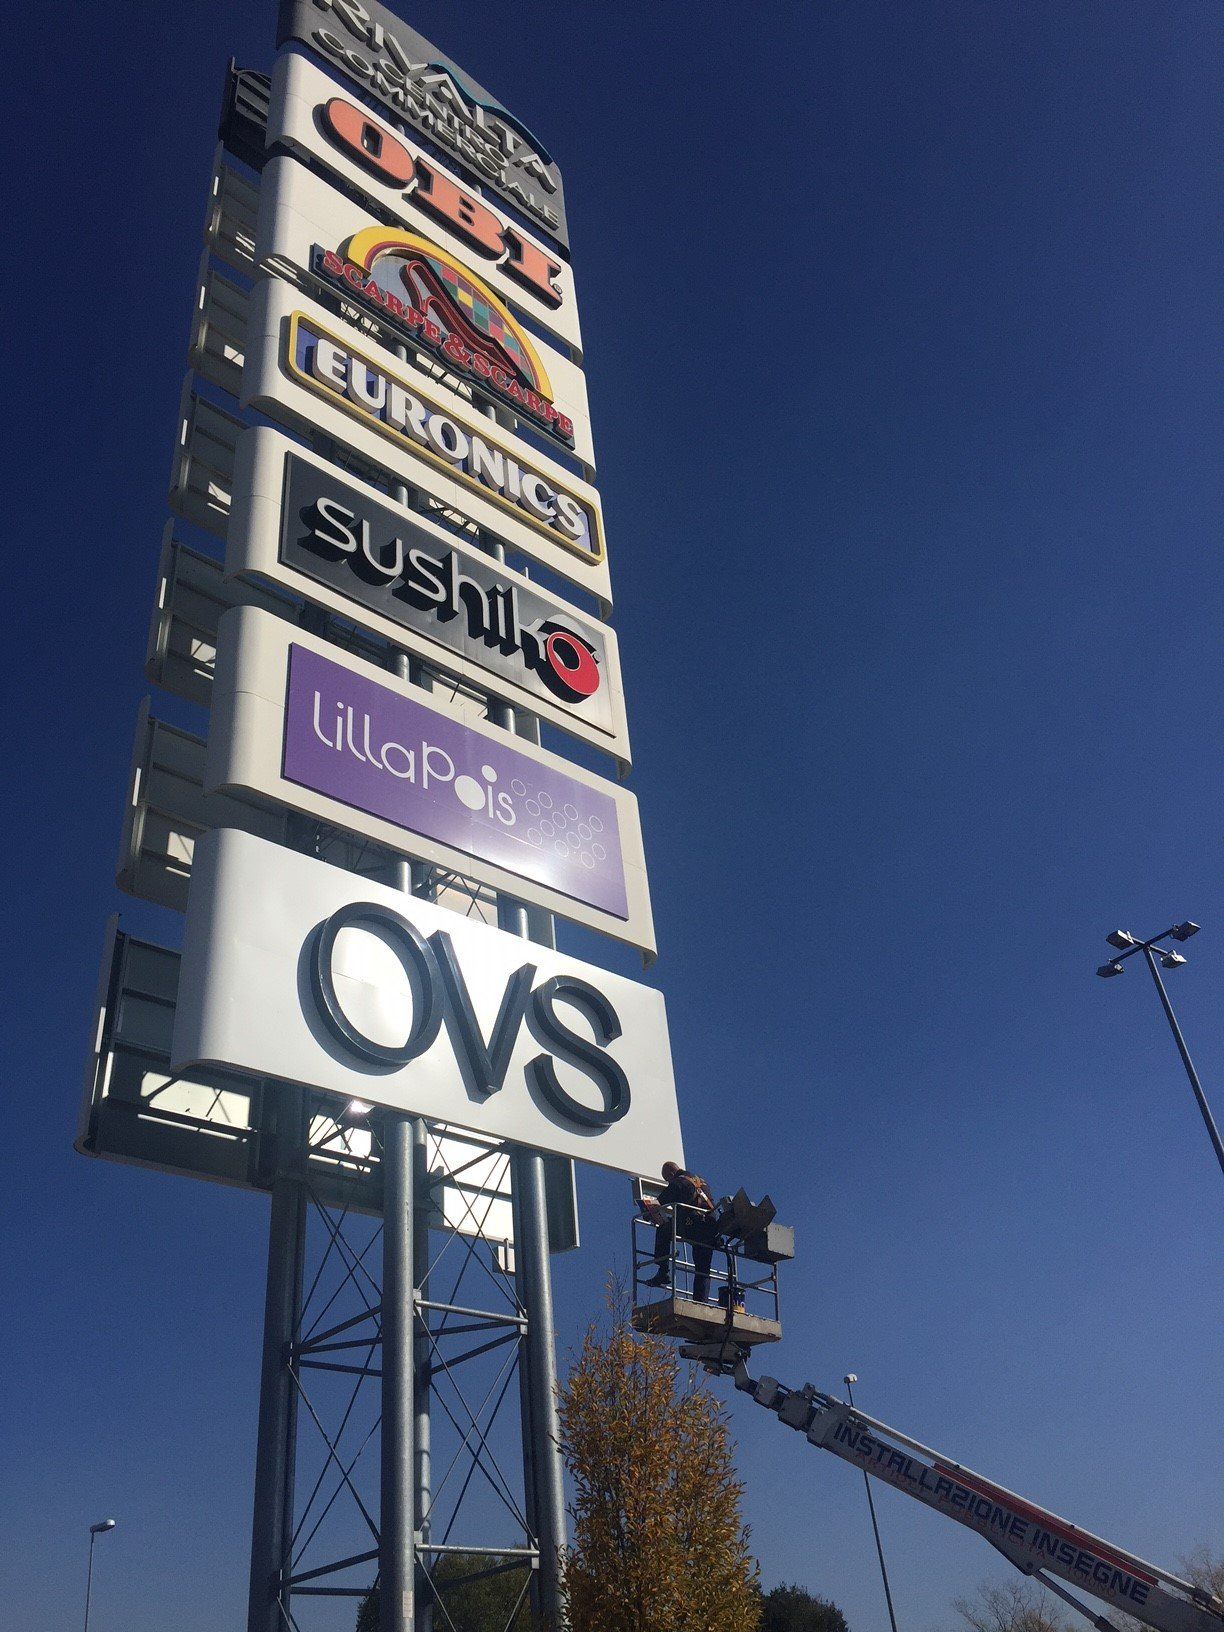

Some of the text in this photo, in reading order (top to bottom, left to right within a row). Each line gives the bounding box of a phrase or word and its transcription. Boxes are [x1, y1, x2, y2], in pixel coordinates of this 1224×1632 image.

[313, 0, 558, 195] RIVALTA
[317, 28, 560, 230] COMMERCIALE
[379, 58, 510, 170] CENTRO
[323, 97, 563, 308] OBI
[313, 338, 587, 540] EURONICS
[298, 901, 631, 1137] OVS
[832, 1421, 1151, 1605] INSTALLAZIONE INSEGNE
